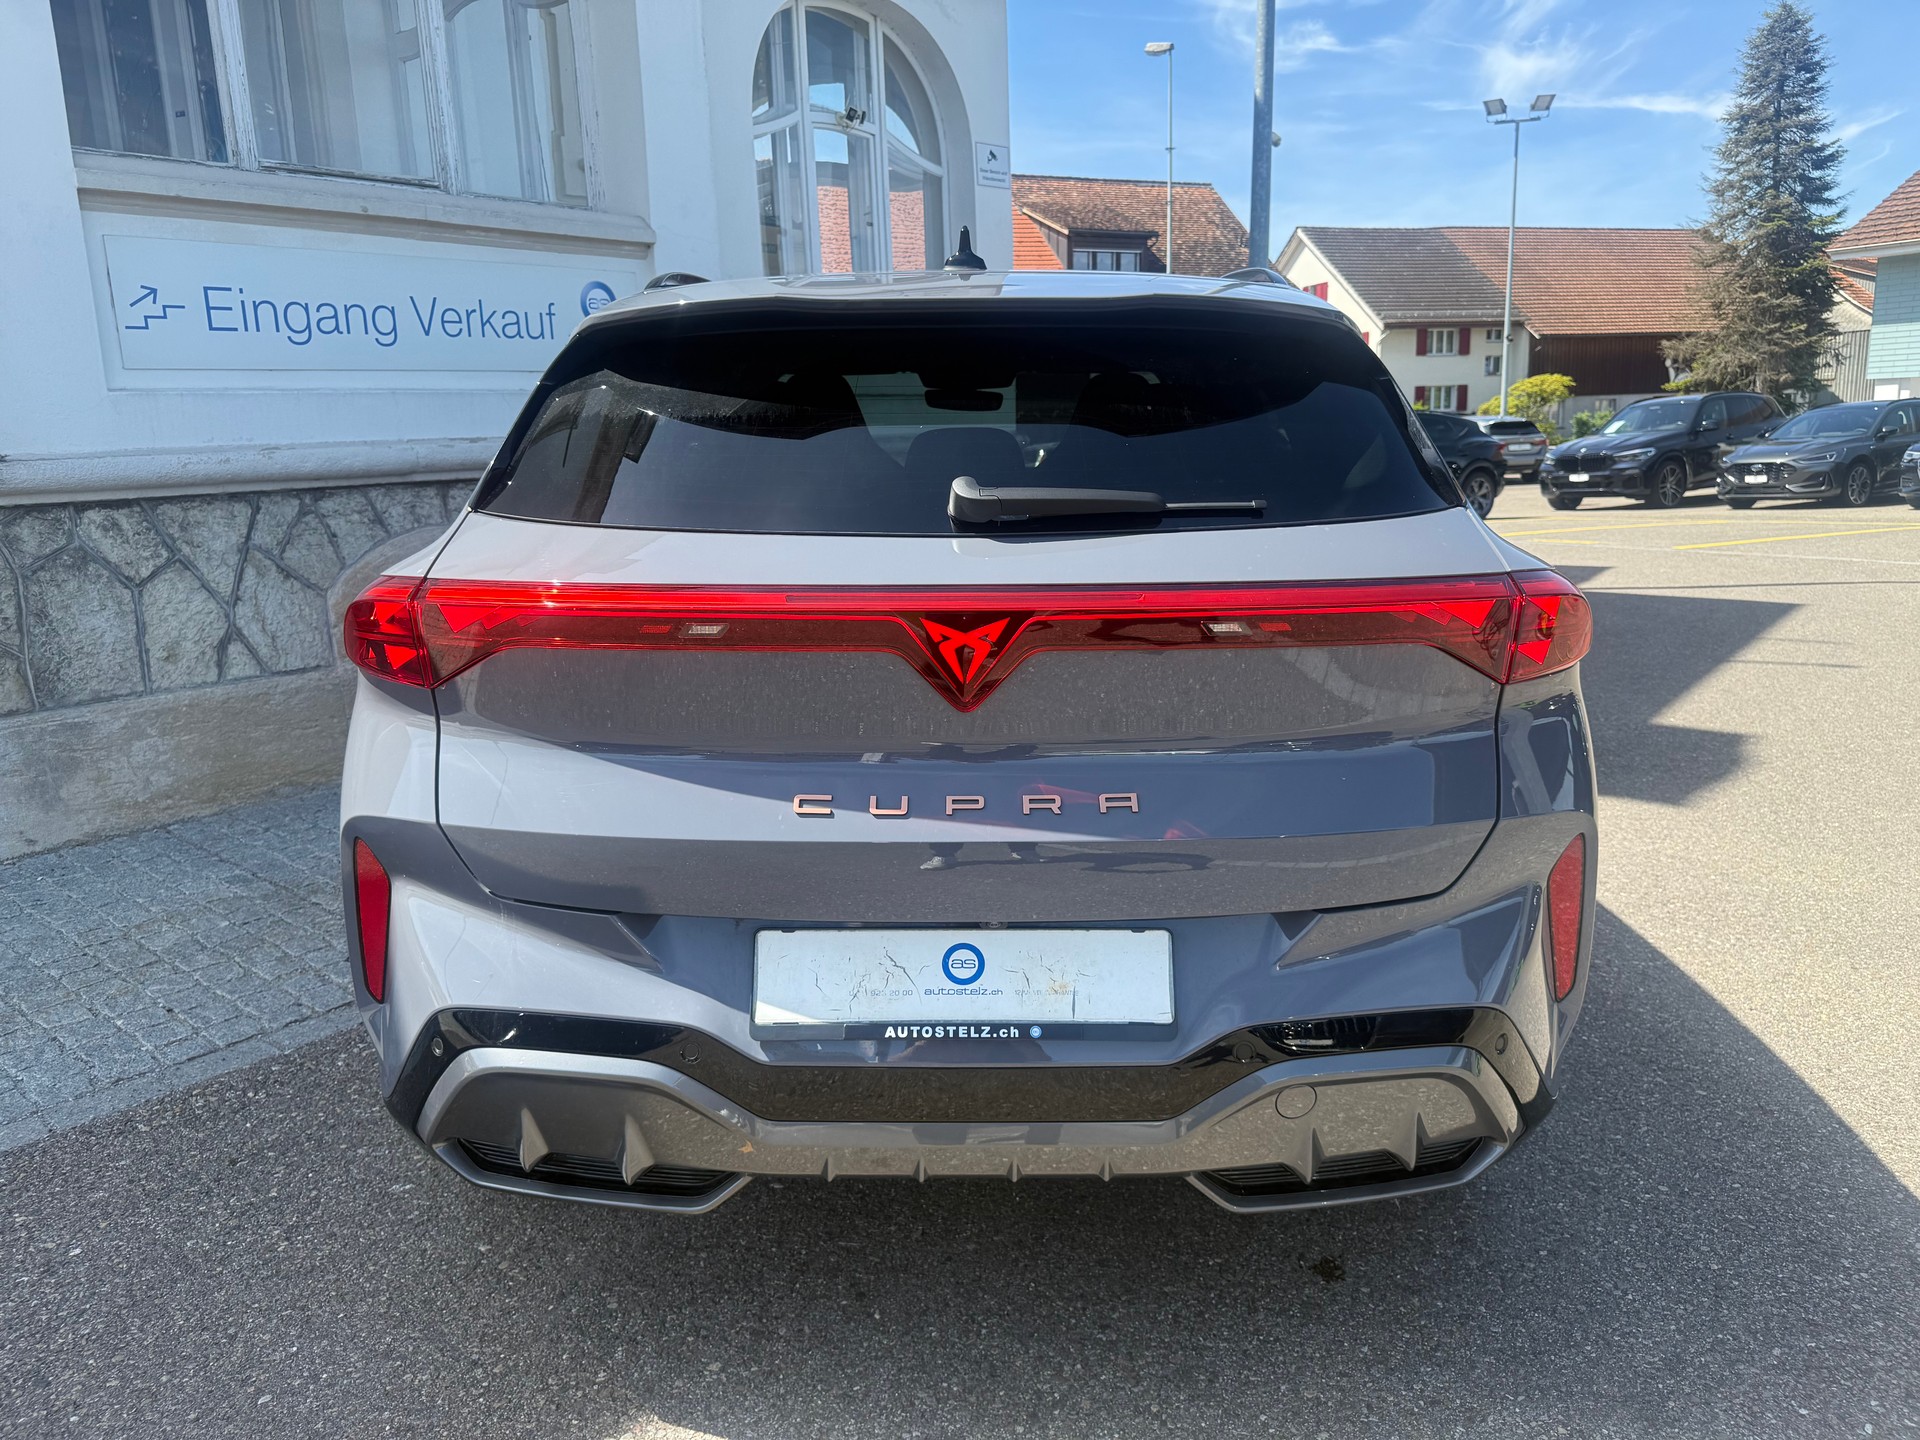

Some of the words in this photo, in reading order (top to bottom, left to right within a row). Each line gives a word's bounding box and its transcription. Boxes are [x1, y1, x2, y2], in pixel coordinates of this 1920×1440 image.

[202, 285, 398, 347] Eingang
[409, 295, 556, 340] Verkauf
[792, 792, 1140, 816] CUPRA
[950, 958, 977, 970] as
[924, 986, 1004, 996] autostelz.ch
[884, 1025, 1020, 1038] AUTOSTELZ.ch
